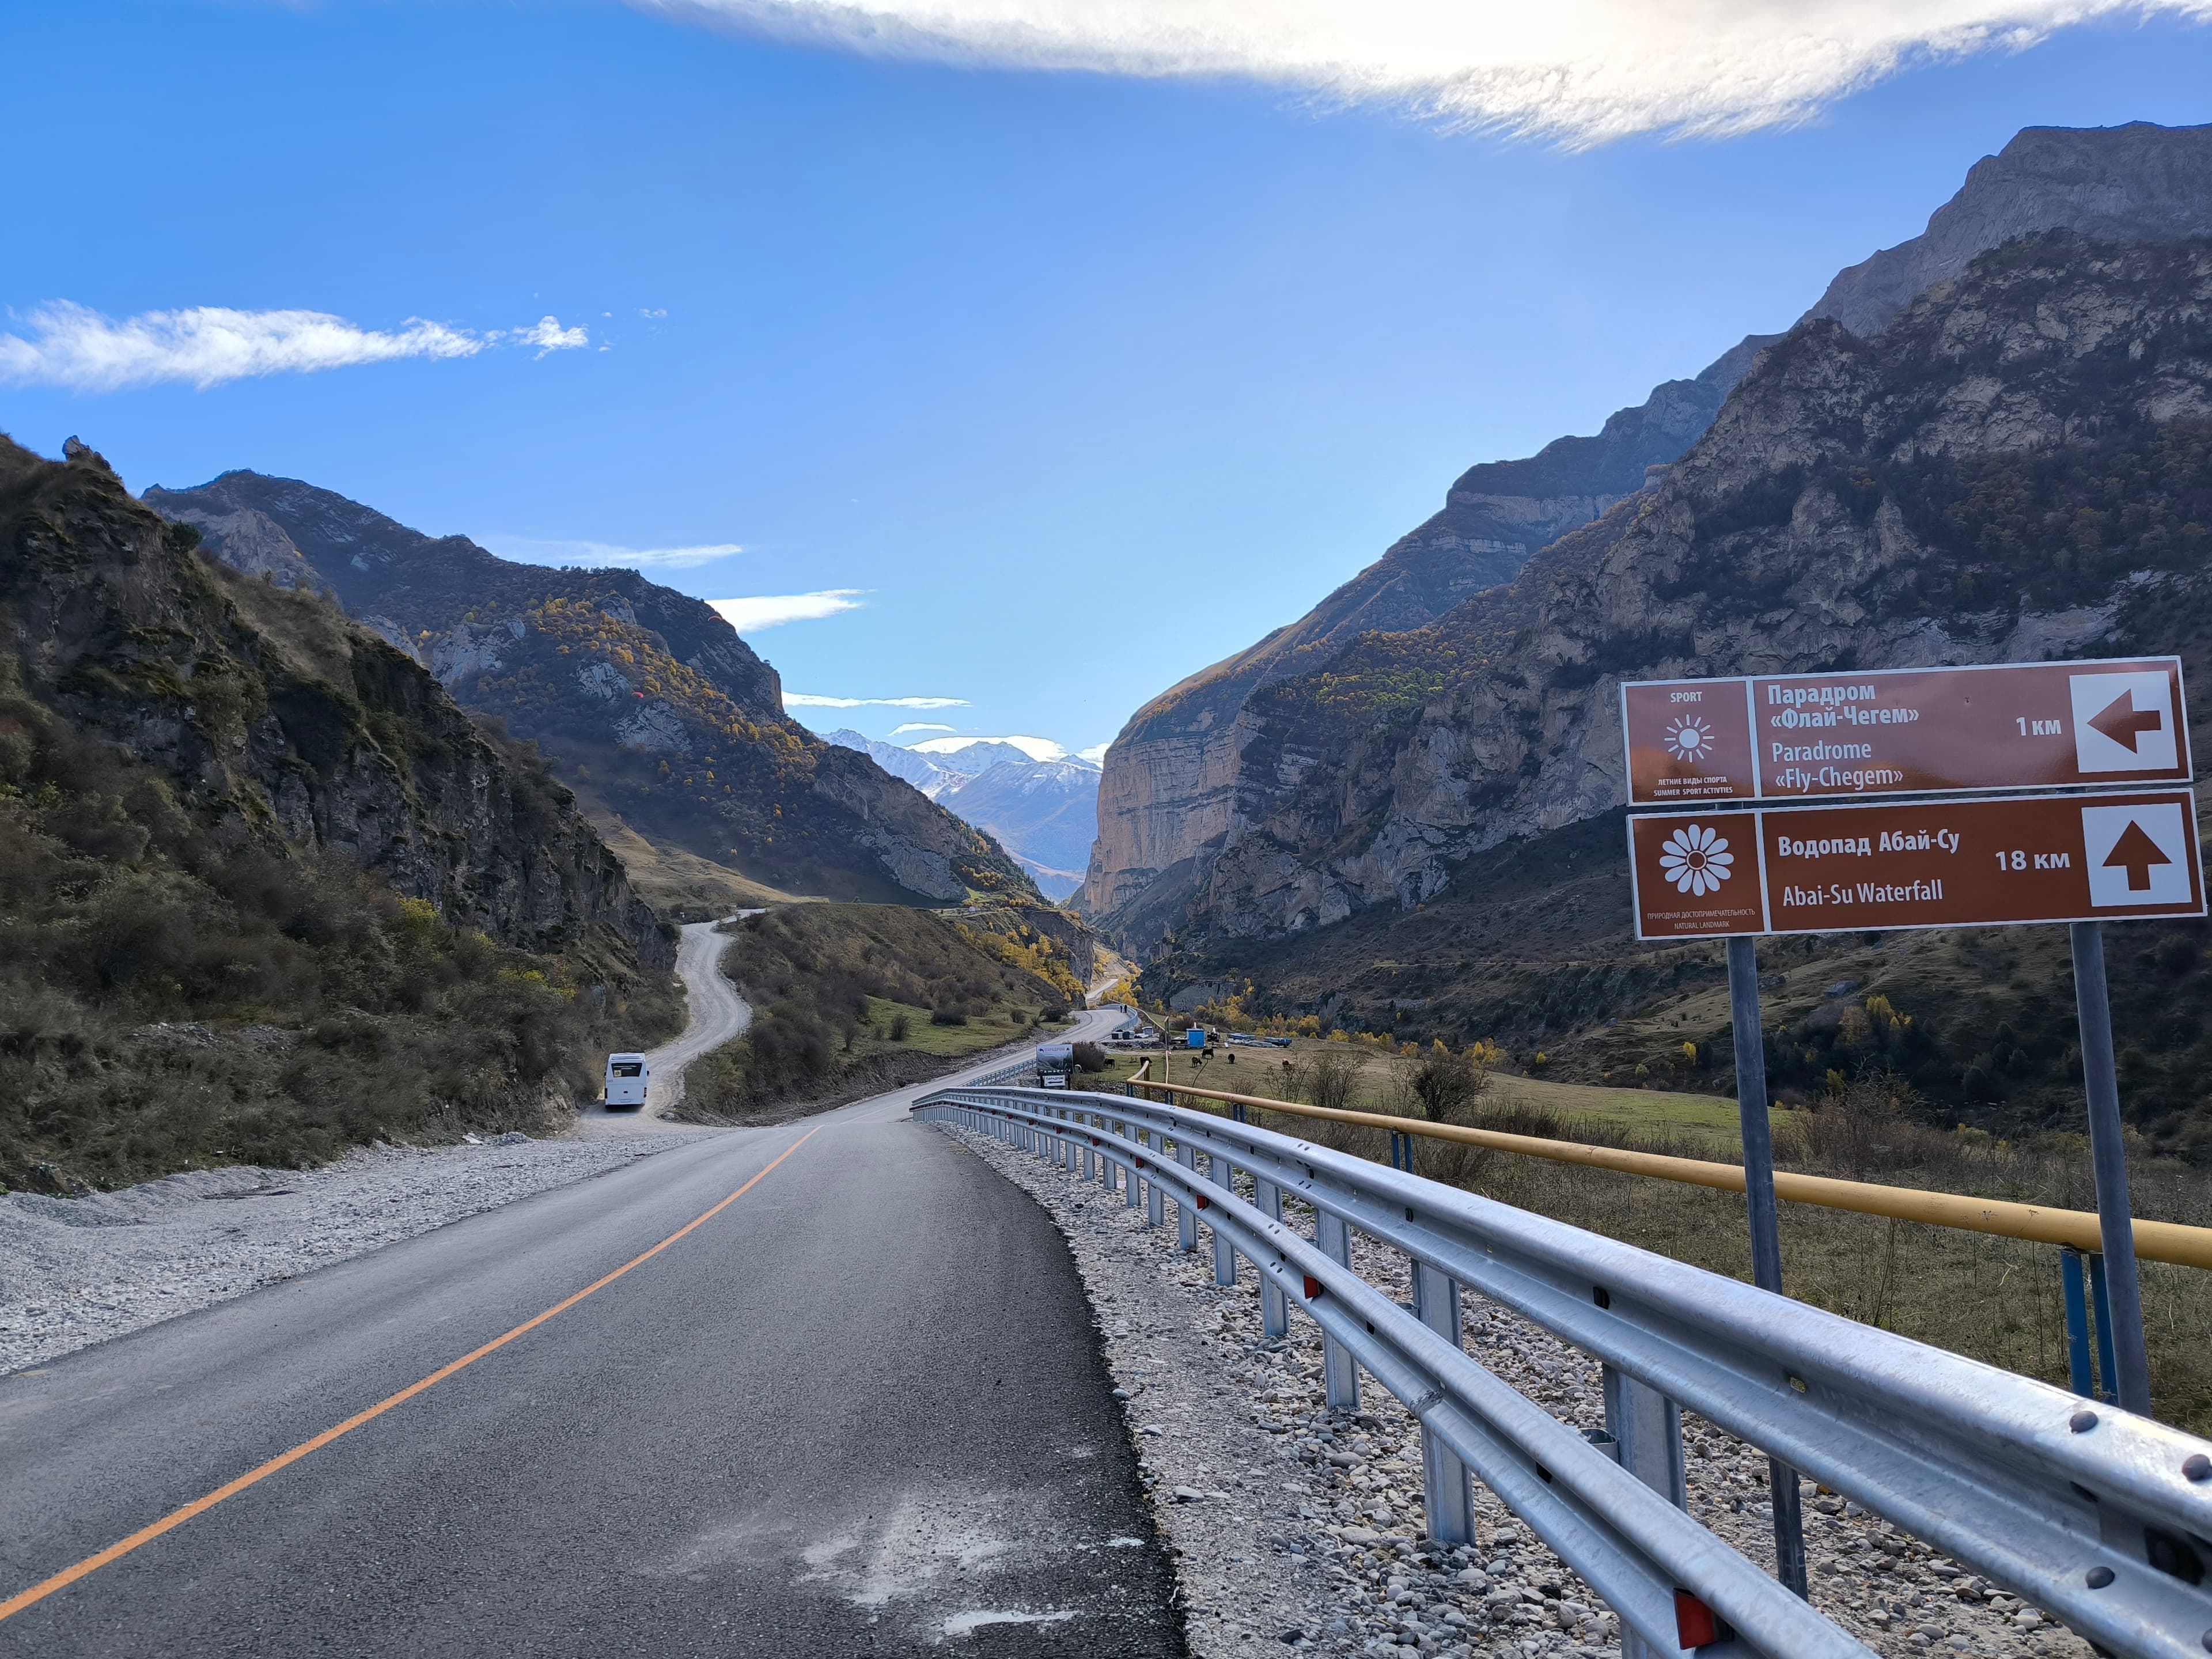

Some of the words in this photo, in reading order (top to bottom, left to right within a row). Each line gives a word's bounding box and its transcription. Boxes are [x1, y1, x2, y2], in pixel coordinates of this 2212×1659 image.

[1671, 691, 1702, 703] SPORT
[1768, 684, 1876, 708] Парадром
[1770, 706, 1919, 728] «Флай-Чегем»
[2016, 717, 2027, 736] 1
[2032, 719, 2062, 736] км
[1772, 740, 1872, 762] Paradrome
[1683, 777, 1702, 785] ВИДЫ
[1775, 767, 1903, 793] «Fly-Chegem»
[1778, 836, 1871, 858] Водопад
[1879, 828, 1960, 854] Абай-Су
[1995, 850, 2027, 871] 18
[2034, 853, 2070, 869] км
[1783, 884, 1853, 906] Abai-Su
[1857, 879, 1942, 904] Waterfall
[1647, 912, 1680, 920] ПРИРОДНАЯ
[1681, 908, 1755, 919] ДОСТОПРИМЕЧАТЕЛЬНОСТЬ
[1699, 921, 1730, 929] LANDMARK
